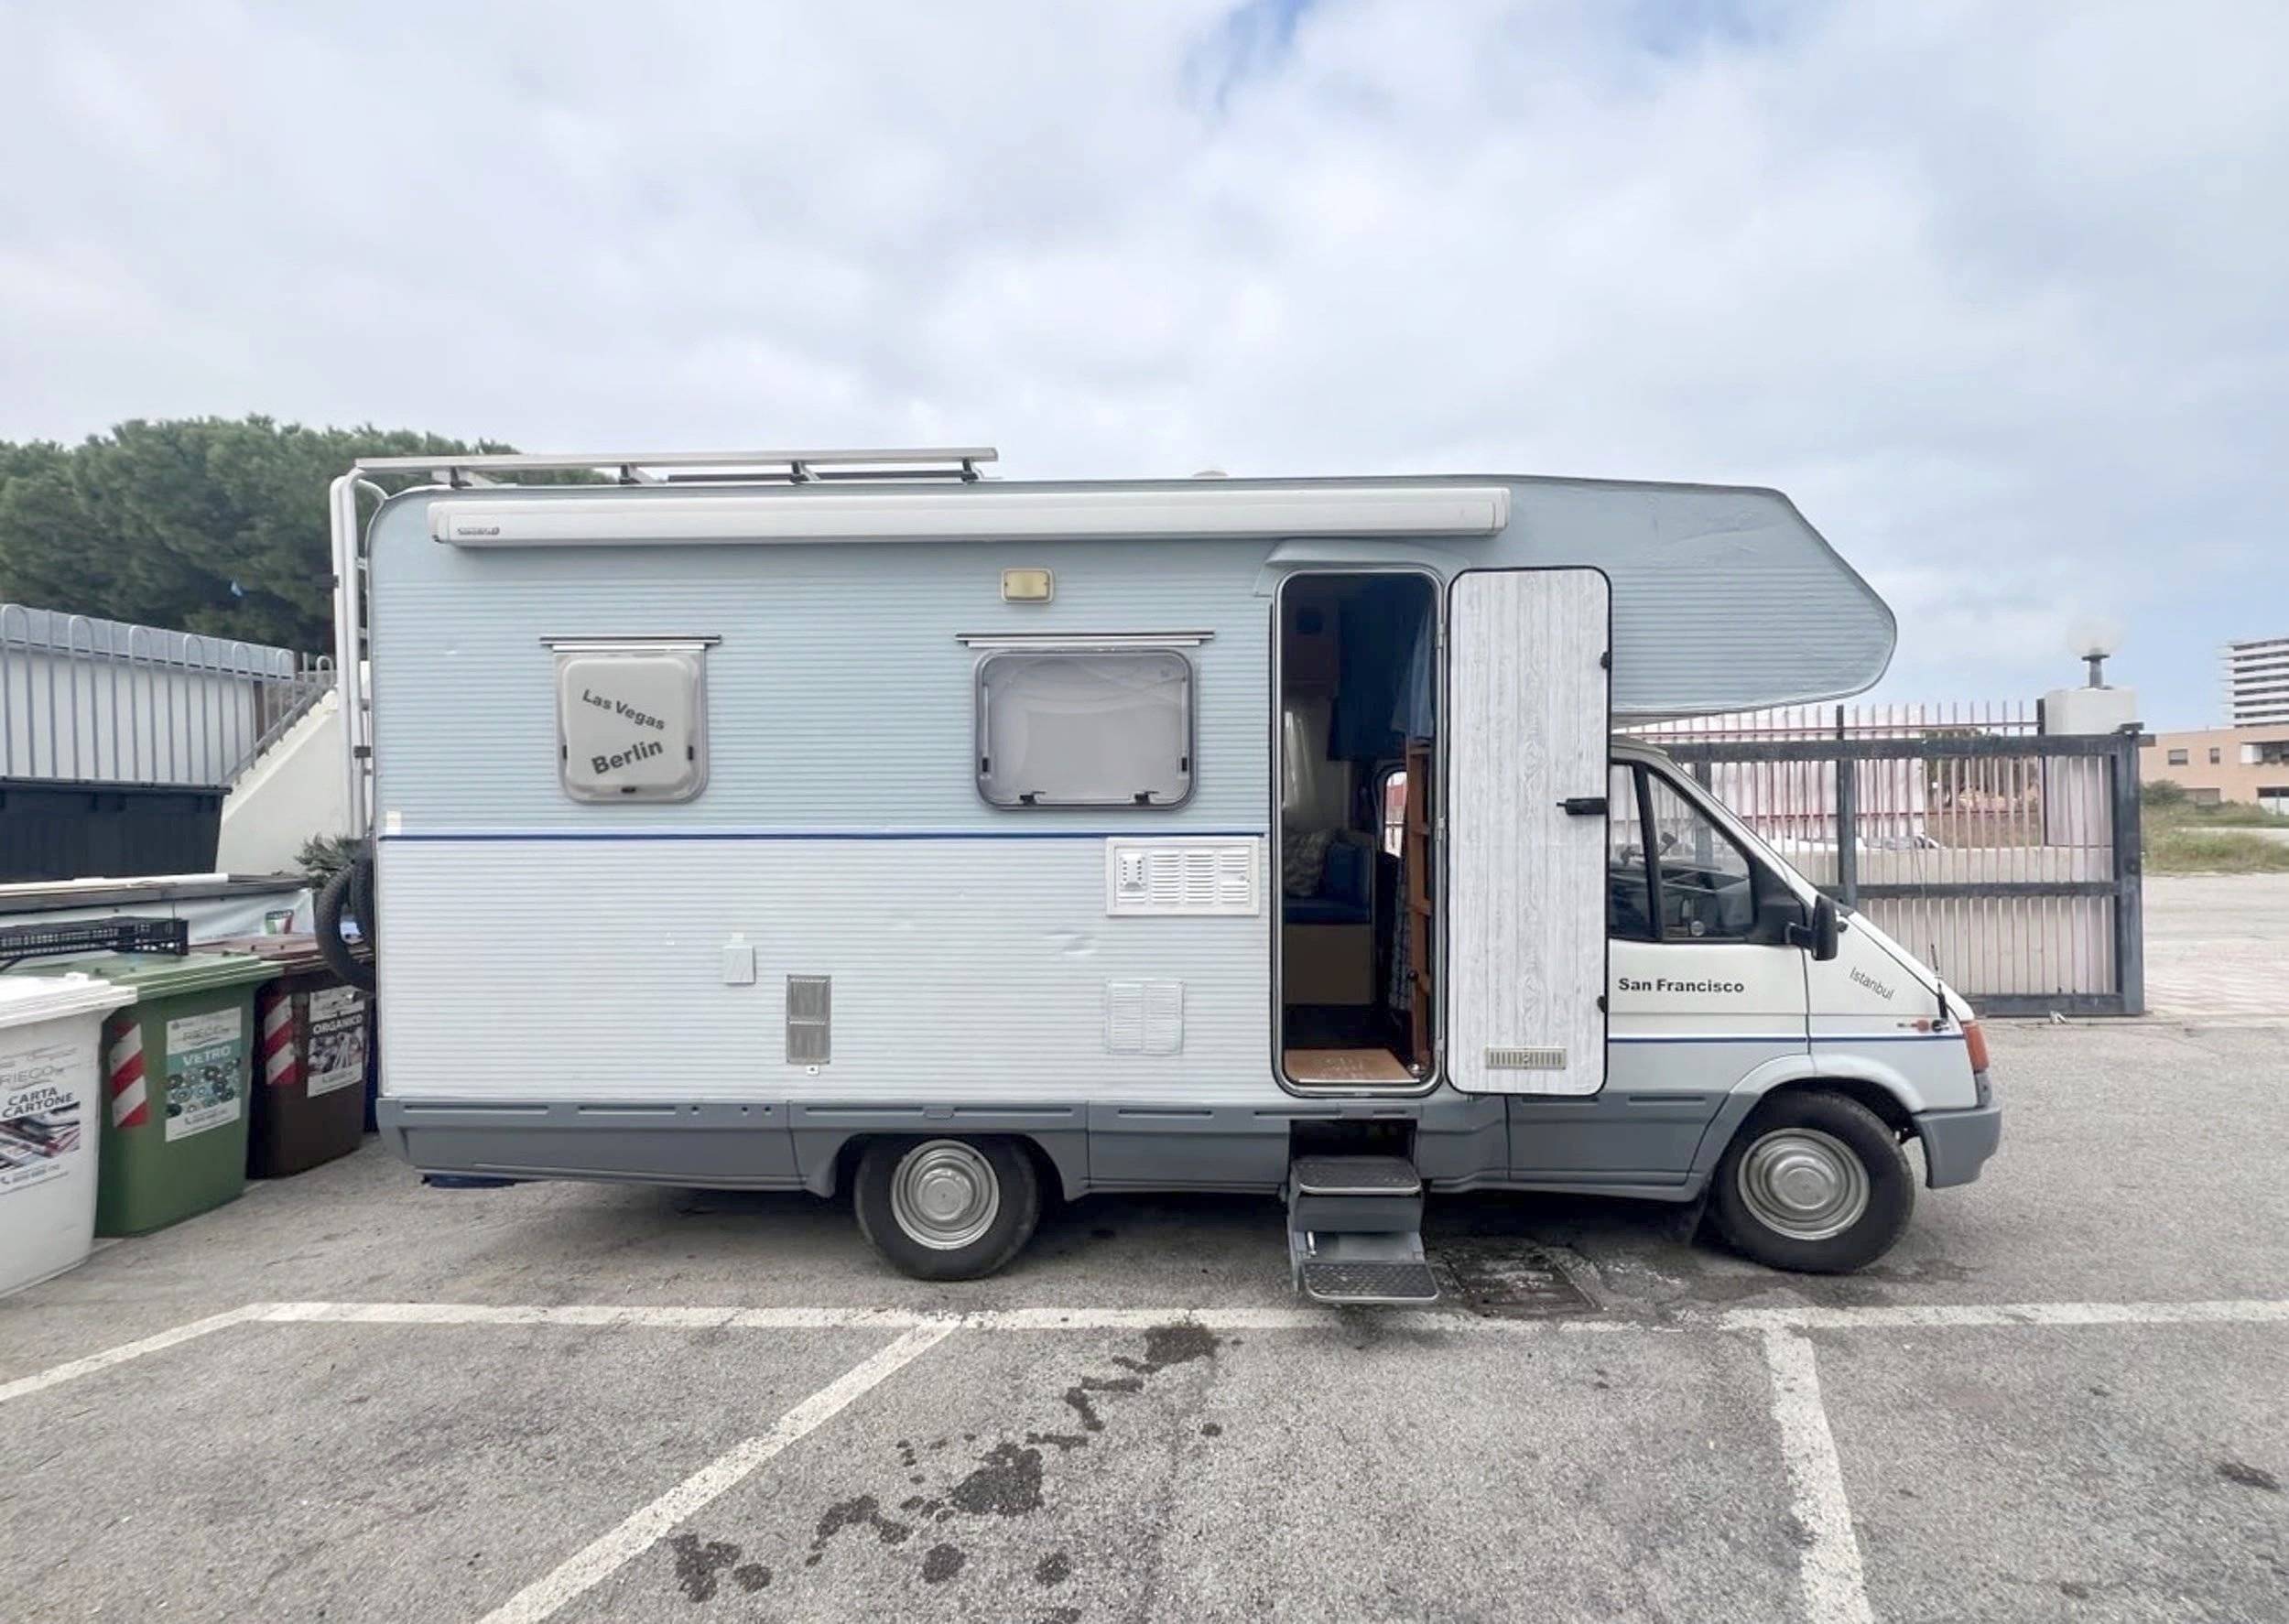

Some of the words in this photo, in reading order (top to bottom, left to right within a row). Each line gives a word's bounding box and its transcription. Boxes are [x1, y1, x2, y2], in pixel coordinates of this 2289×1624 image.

[582, 689, 613, 710] Las
[615, 700, 666, 730] Vegas
[591, 741, 664, 774] Berlin
[1618, 978, 1653, 991] San
[1655, 979, 1745, 993] Francisco
[1849, 967, 1895, 1001] Istanbul
[312, 1013, 363, 1034] ORGANICO
[182, 1045, 232, 1066] VETRO
[2, 1092, 73, 1119] CARTONE
[7, 1087, 58, 1106] CARTA
